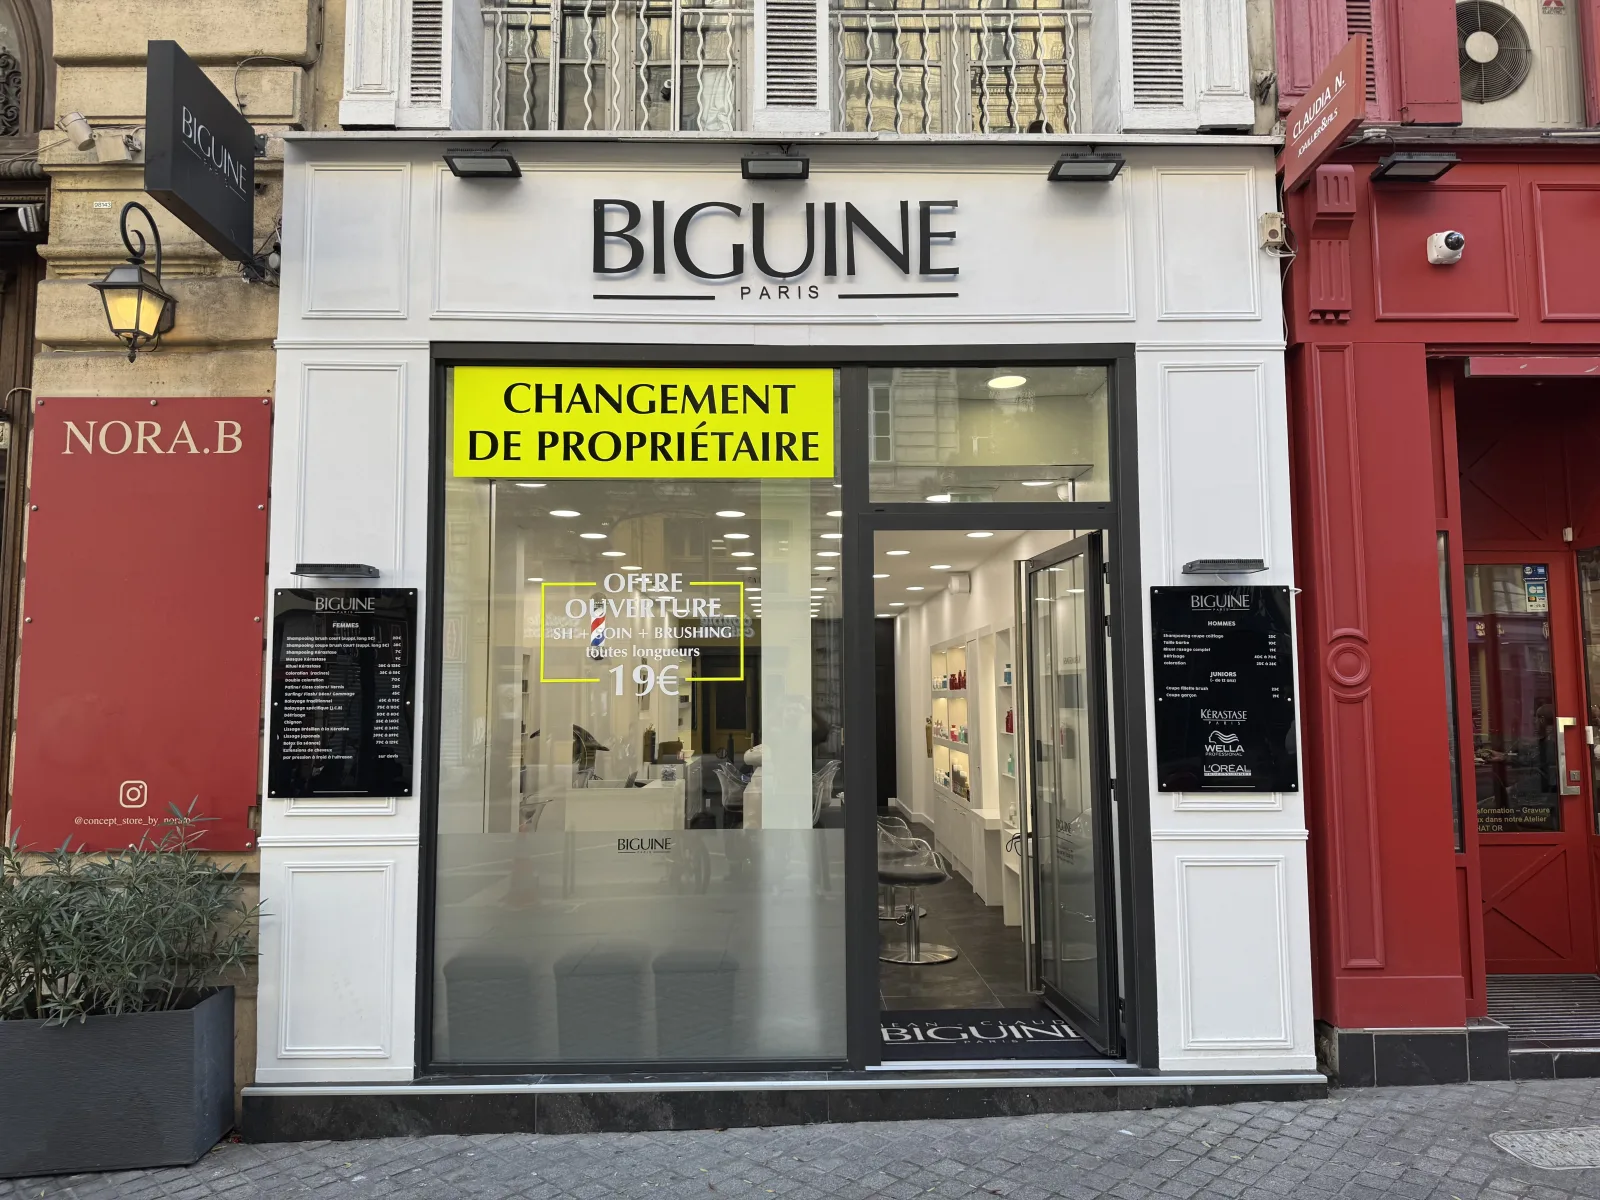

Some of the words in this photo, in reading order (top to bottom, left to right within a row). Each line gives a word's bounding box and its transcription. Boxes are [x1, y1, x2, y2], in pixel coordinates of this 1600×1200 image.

[1292, 86, 1332, 139] CLAUDIA
[1334, 70, 1345, 92] N.
[182, 105, 247, 194] BIGUINE
[592, 199, 960, 280] BIGUINE
[740, 285, 821, 300] PARIS
[503, 382, 797, 415] CHANGEMENT
[61, 420, 243, 455] NORA.B
[468, 430, 523, 462] DE
[537, 420, 820, 463] PROPRIÉTAIRE
[603, 572, 683, 593] OFFRE
[315, 597, 375, 610] BIGUINE
[565, 598, 721, 619] OUVERTURE
[1191, 595, 1250, 608] BIGUINE
[553, 628, 573, 640] SH
[594, 627, 632, 639] SOIN
[654, 626, 732, 639] BRUSHING
[585, 646, 628, 658] toutes
[632, 645, 700, 660] longueurs
[609, 664, 680, 696] 19€
[1200, 708, 1248, 720] KÉRASTASE
[1204, 744, 1245, 753] WELLA
[1203, 764, 1248, 772] L'ORÉAL
[617, 837, 672, 850] BIGUINE
[880, 1025, 1081, 1042] BIGUINE
